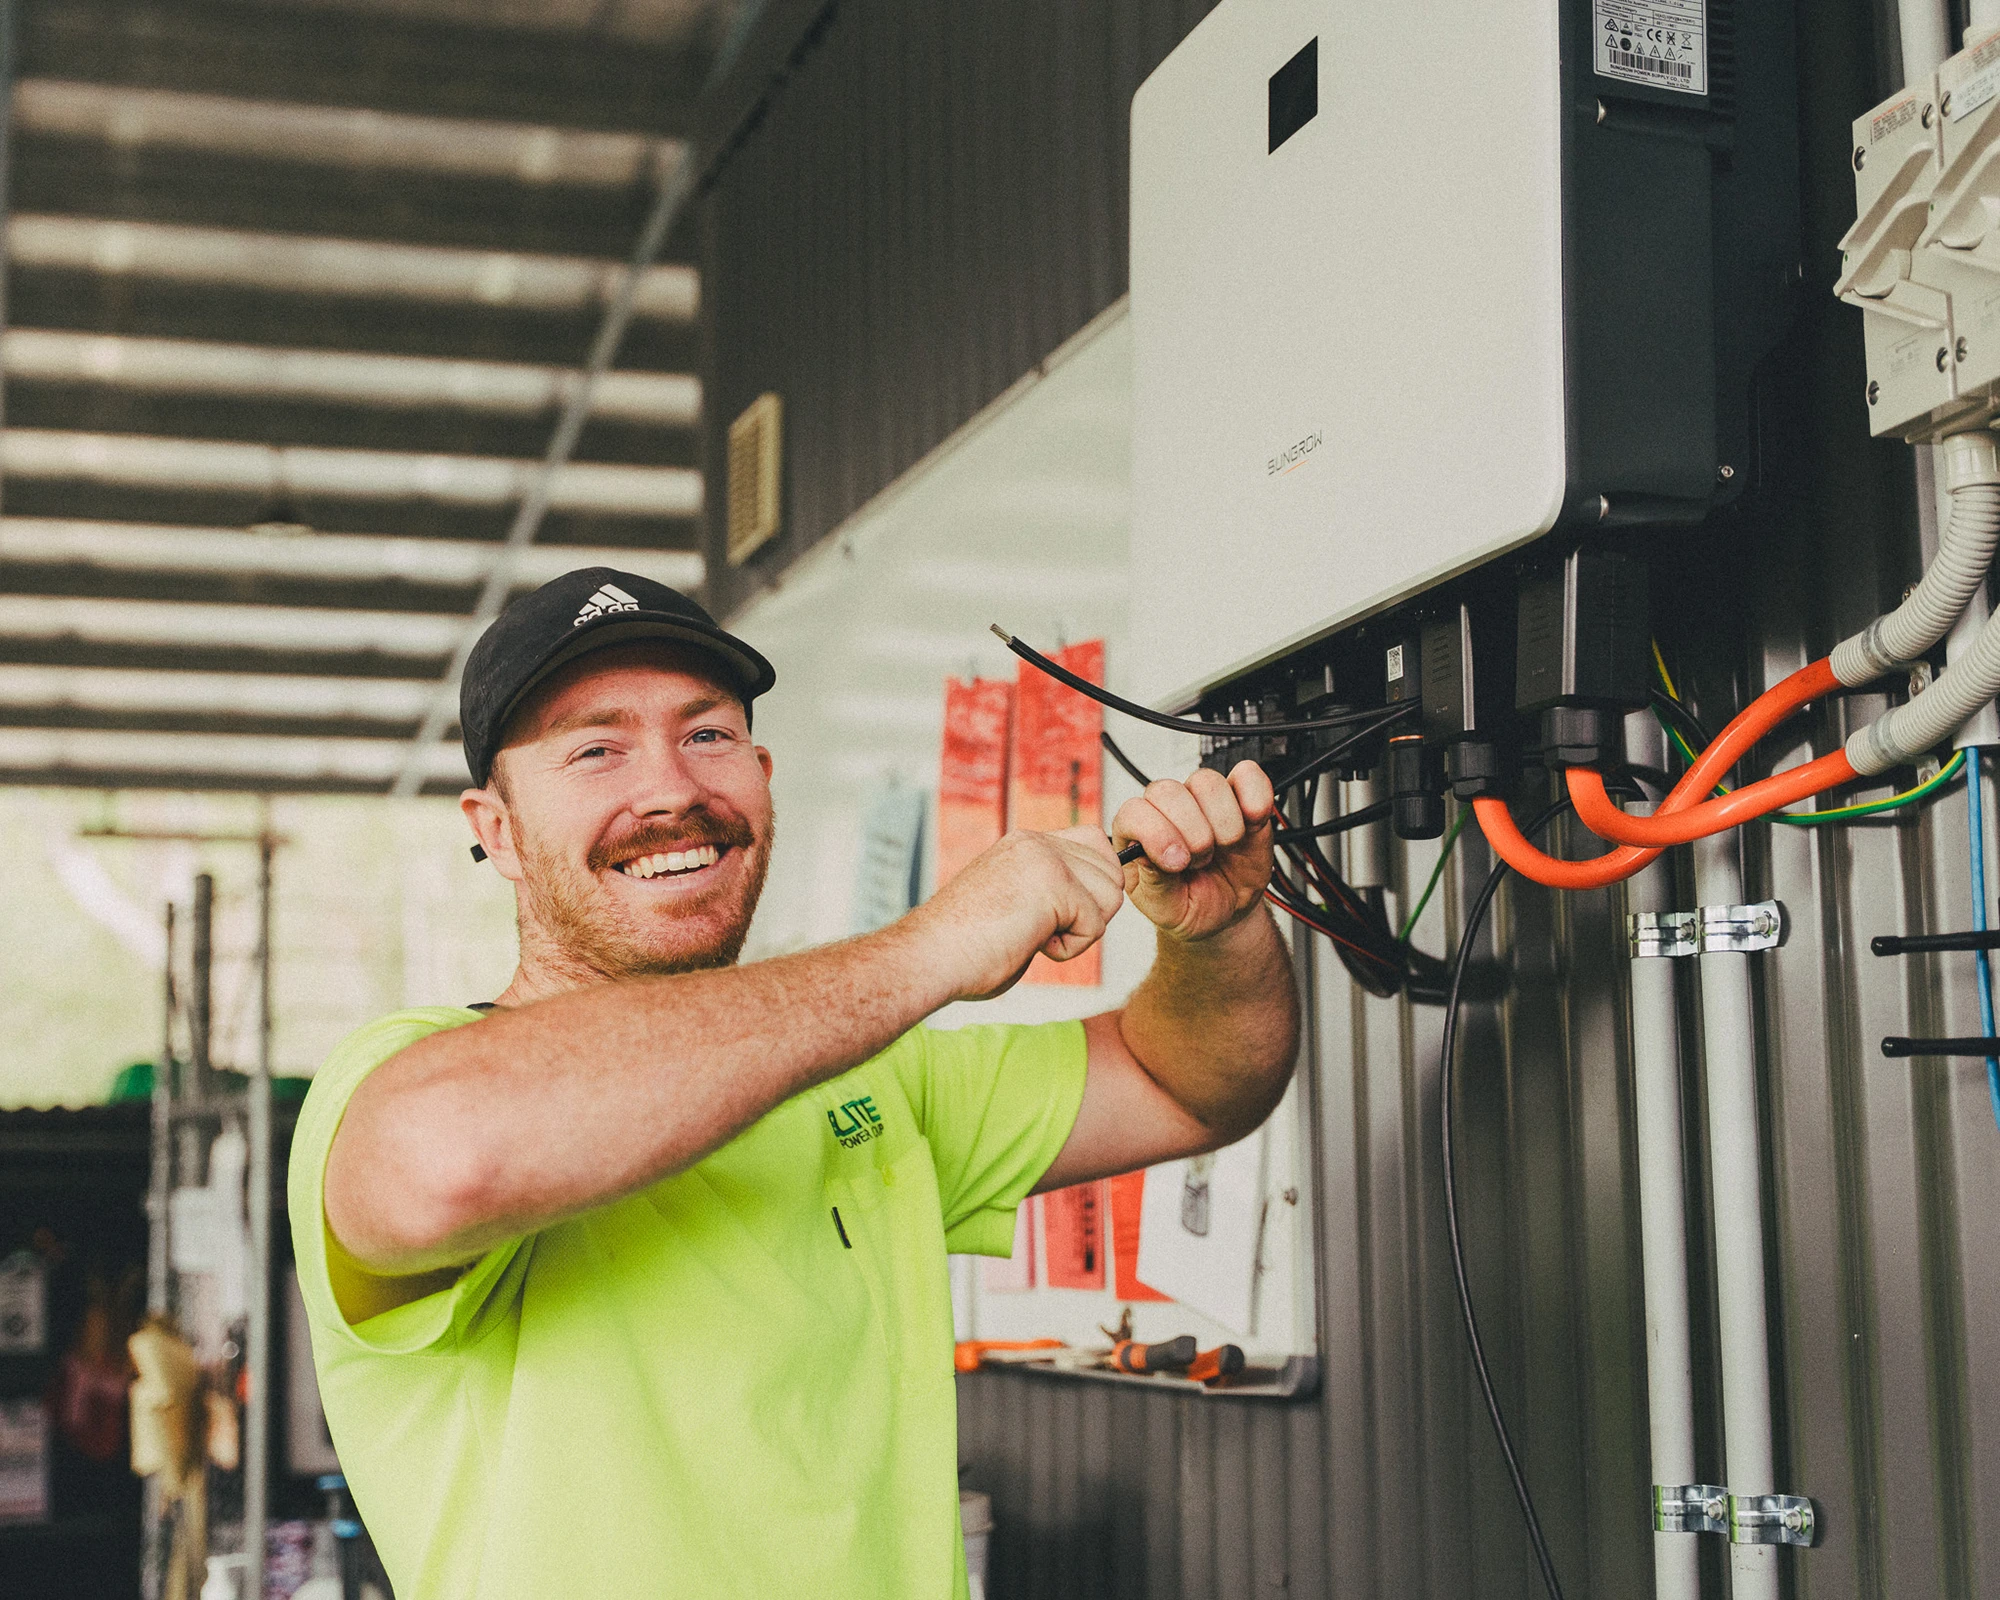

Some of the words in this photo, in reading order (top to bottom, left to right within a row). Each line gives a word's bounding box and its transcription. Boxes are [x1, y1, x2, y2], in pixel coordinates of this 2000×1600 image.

[1610, 64, 1634, 74] SUNGROW
[1634, 68, 1651, 77] POWER
[1652, 72, 1669, 80] SUPPLY
[1268, 429, 1322, 475] SUNGROW
[840, 1129, 873, 1149] POWER
